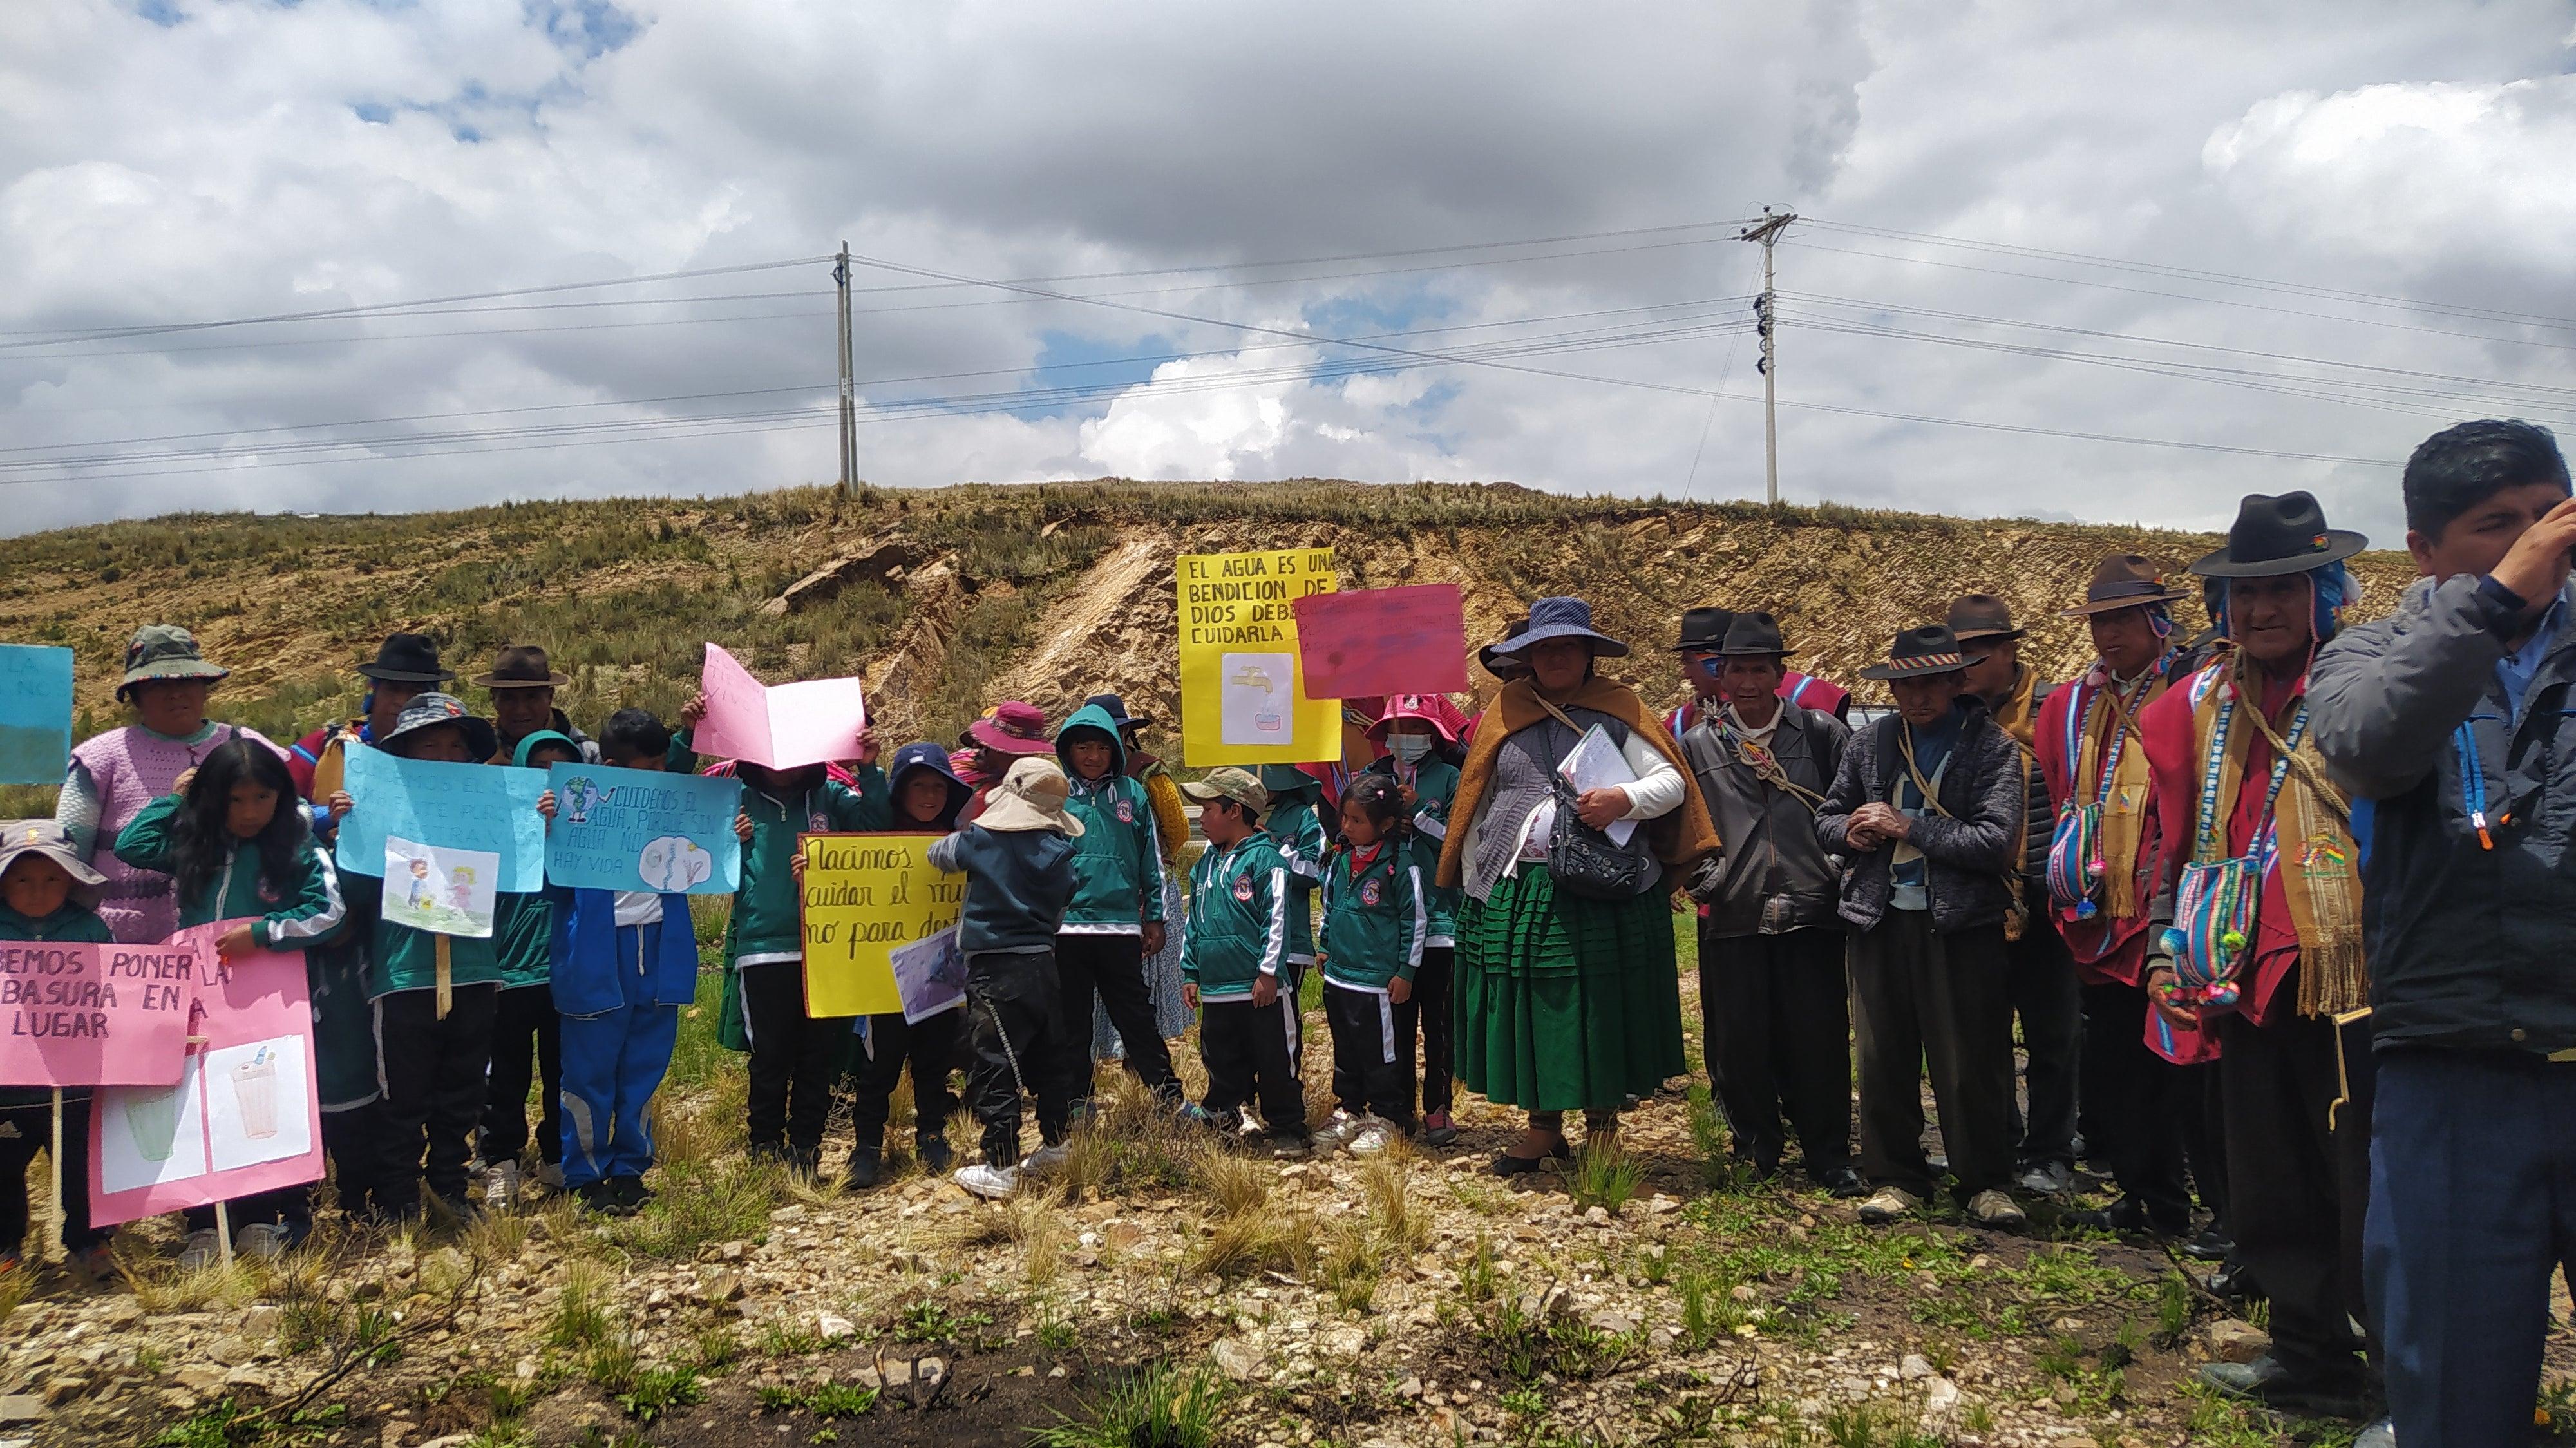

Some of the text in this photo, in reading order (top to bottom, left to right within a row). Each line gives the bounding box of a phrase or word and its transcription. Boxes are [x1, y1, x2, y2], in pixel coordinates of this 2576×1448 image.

[1189, 561, 1209, 579] EL
[1222, 557, 1267, 578] AGUA
[1278, 555, 1296, 575] ES
[1189, 580, 1287, 603] BENDICION
[1191, 605, 1235, 624] DIOS
[1192, 625, 1284, 643] CUIDARLA
[614, 785, 678, 812] CUIDEMOS
[567, 826, 642, 853] AGUA NO
[554, 852, 623, 874] HAY VIDA
[805, 880, 876, 908] cuidar
[888, 870, 911, 905] el
[805, 920, 840, 944] no
[847, 921, 910, 960] para
[109, 952, 193, 980] PONER
[1, 979, 182, 1011] BASURA EN
[12, 1011, 109, 1039] LUGAR
